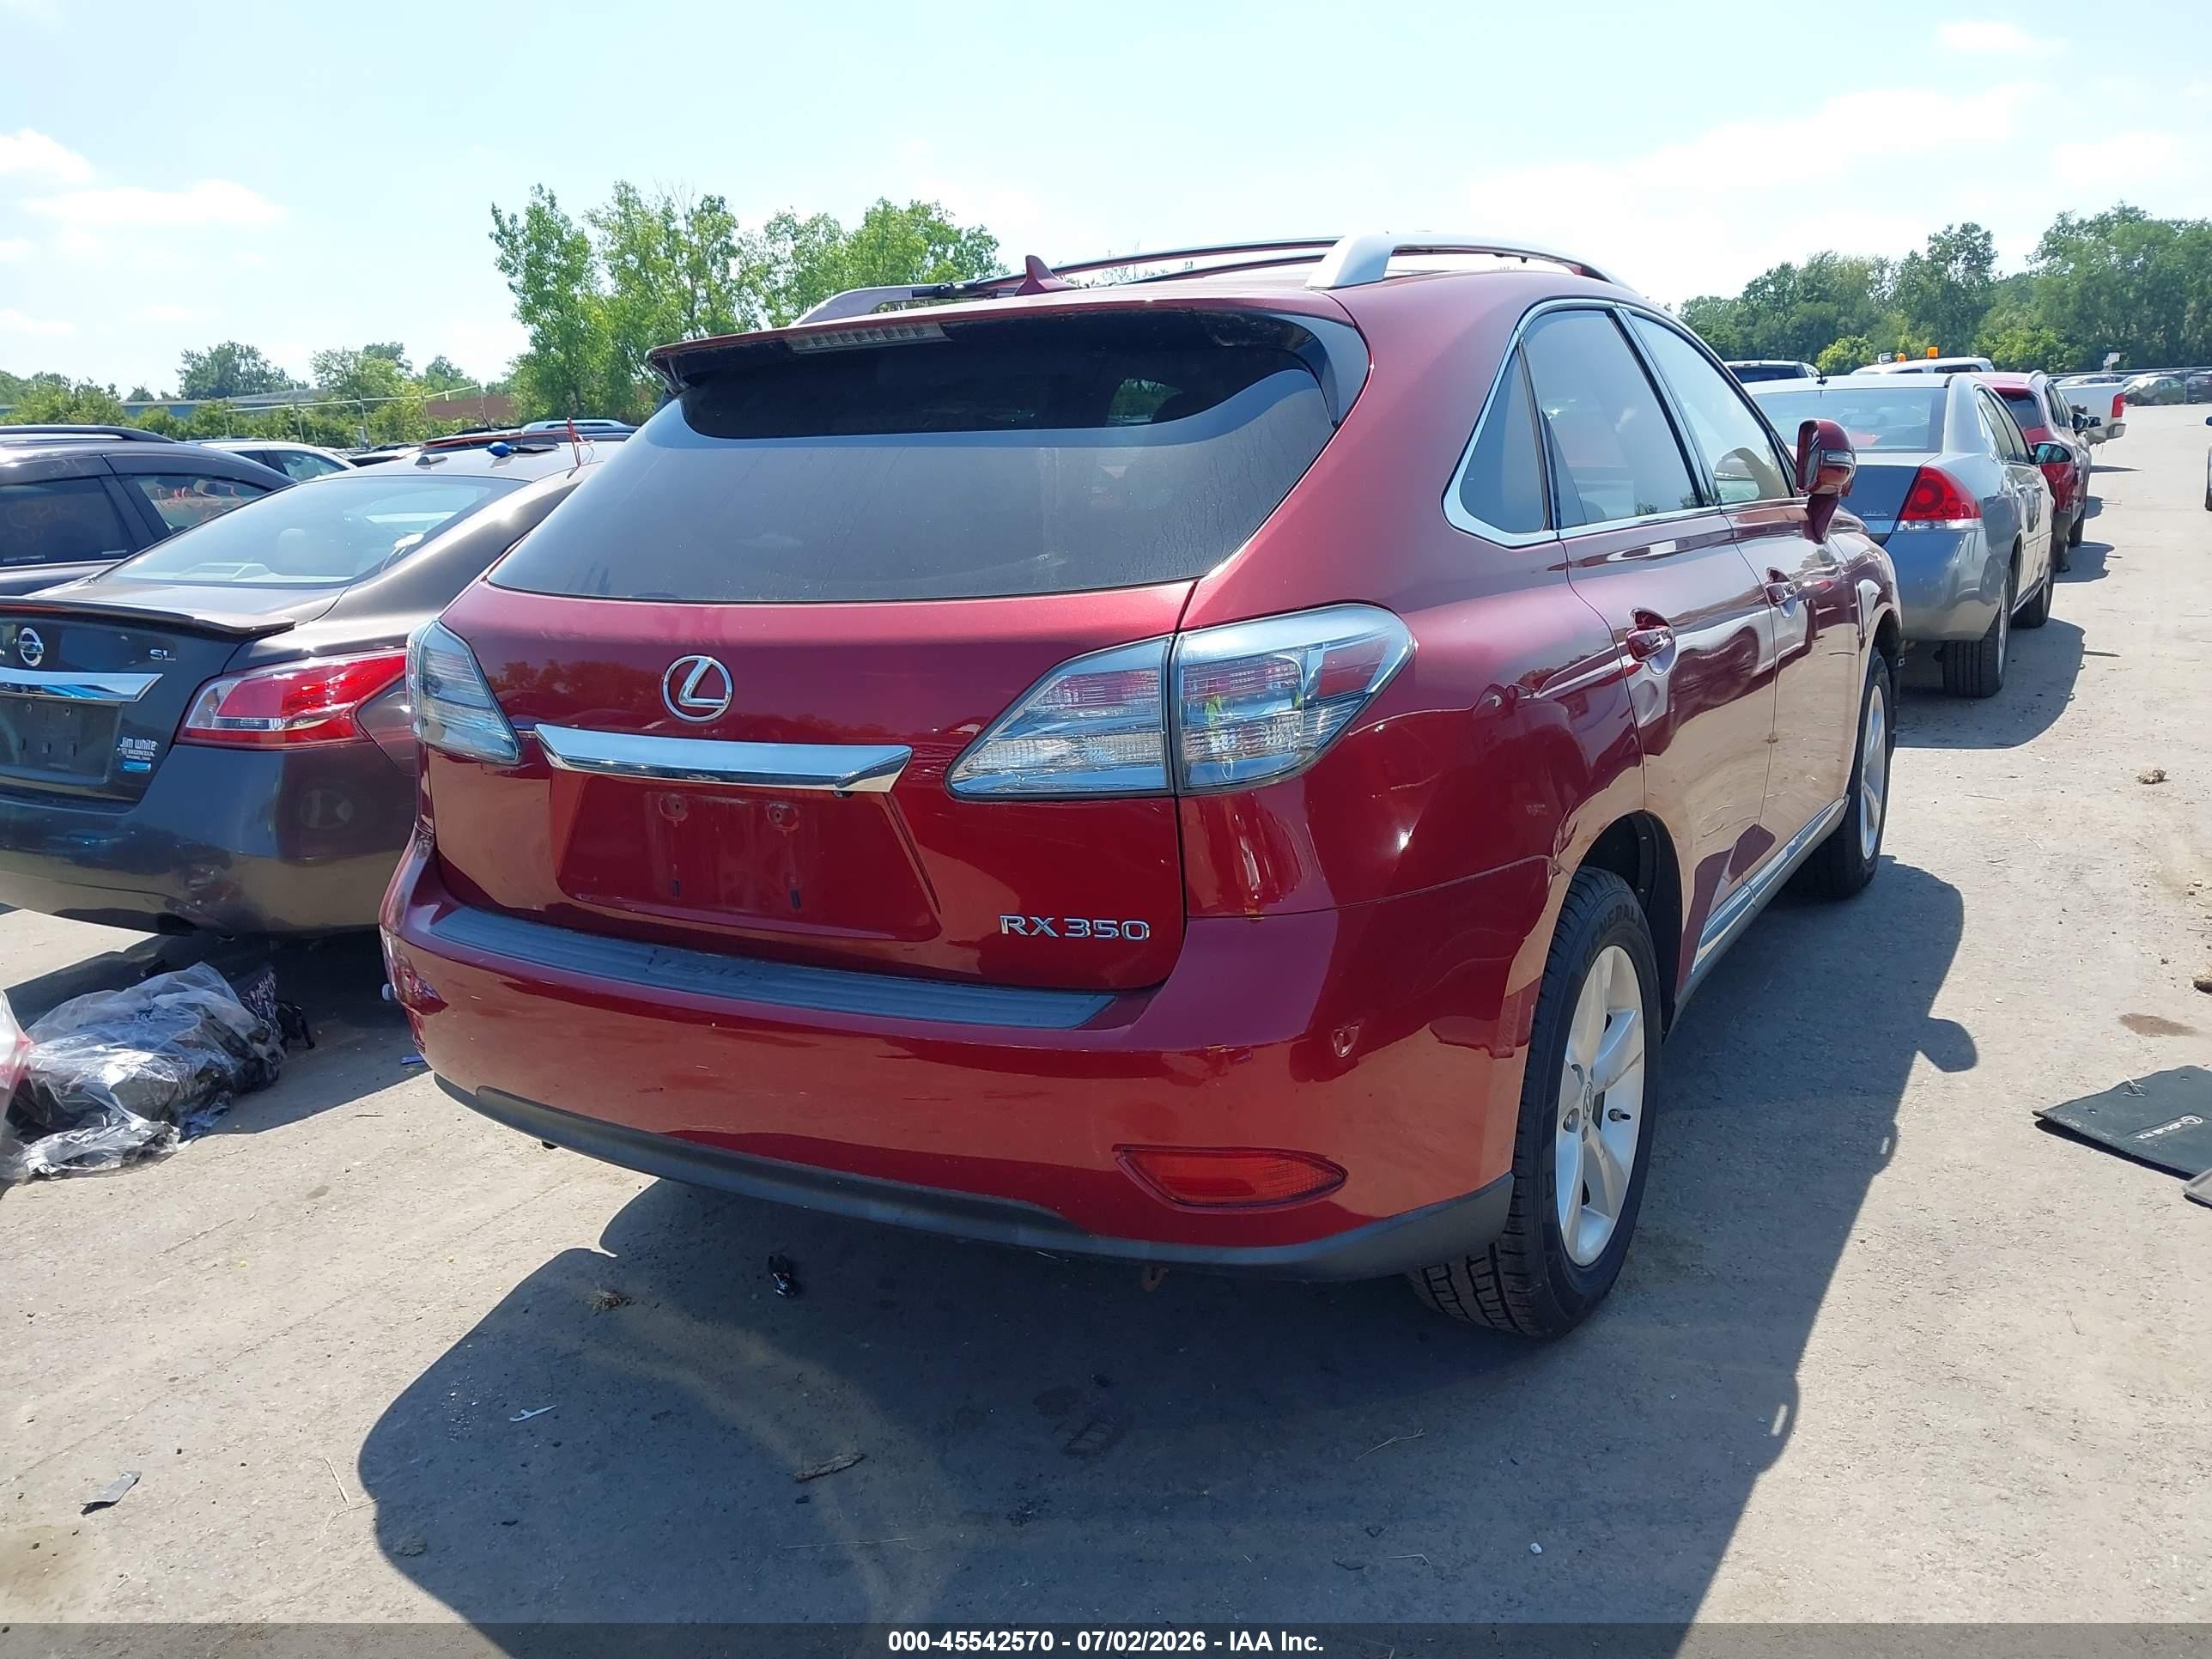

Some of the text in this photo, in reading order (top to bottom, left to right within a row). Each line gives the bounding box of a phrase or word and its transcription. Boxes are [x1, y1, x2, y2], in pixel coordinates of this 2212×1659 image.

[149, 649, 177, 661] SL
[1000, 915, 1151, 941] RX 350
